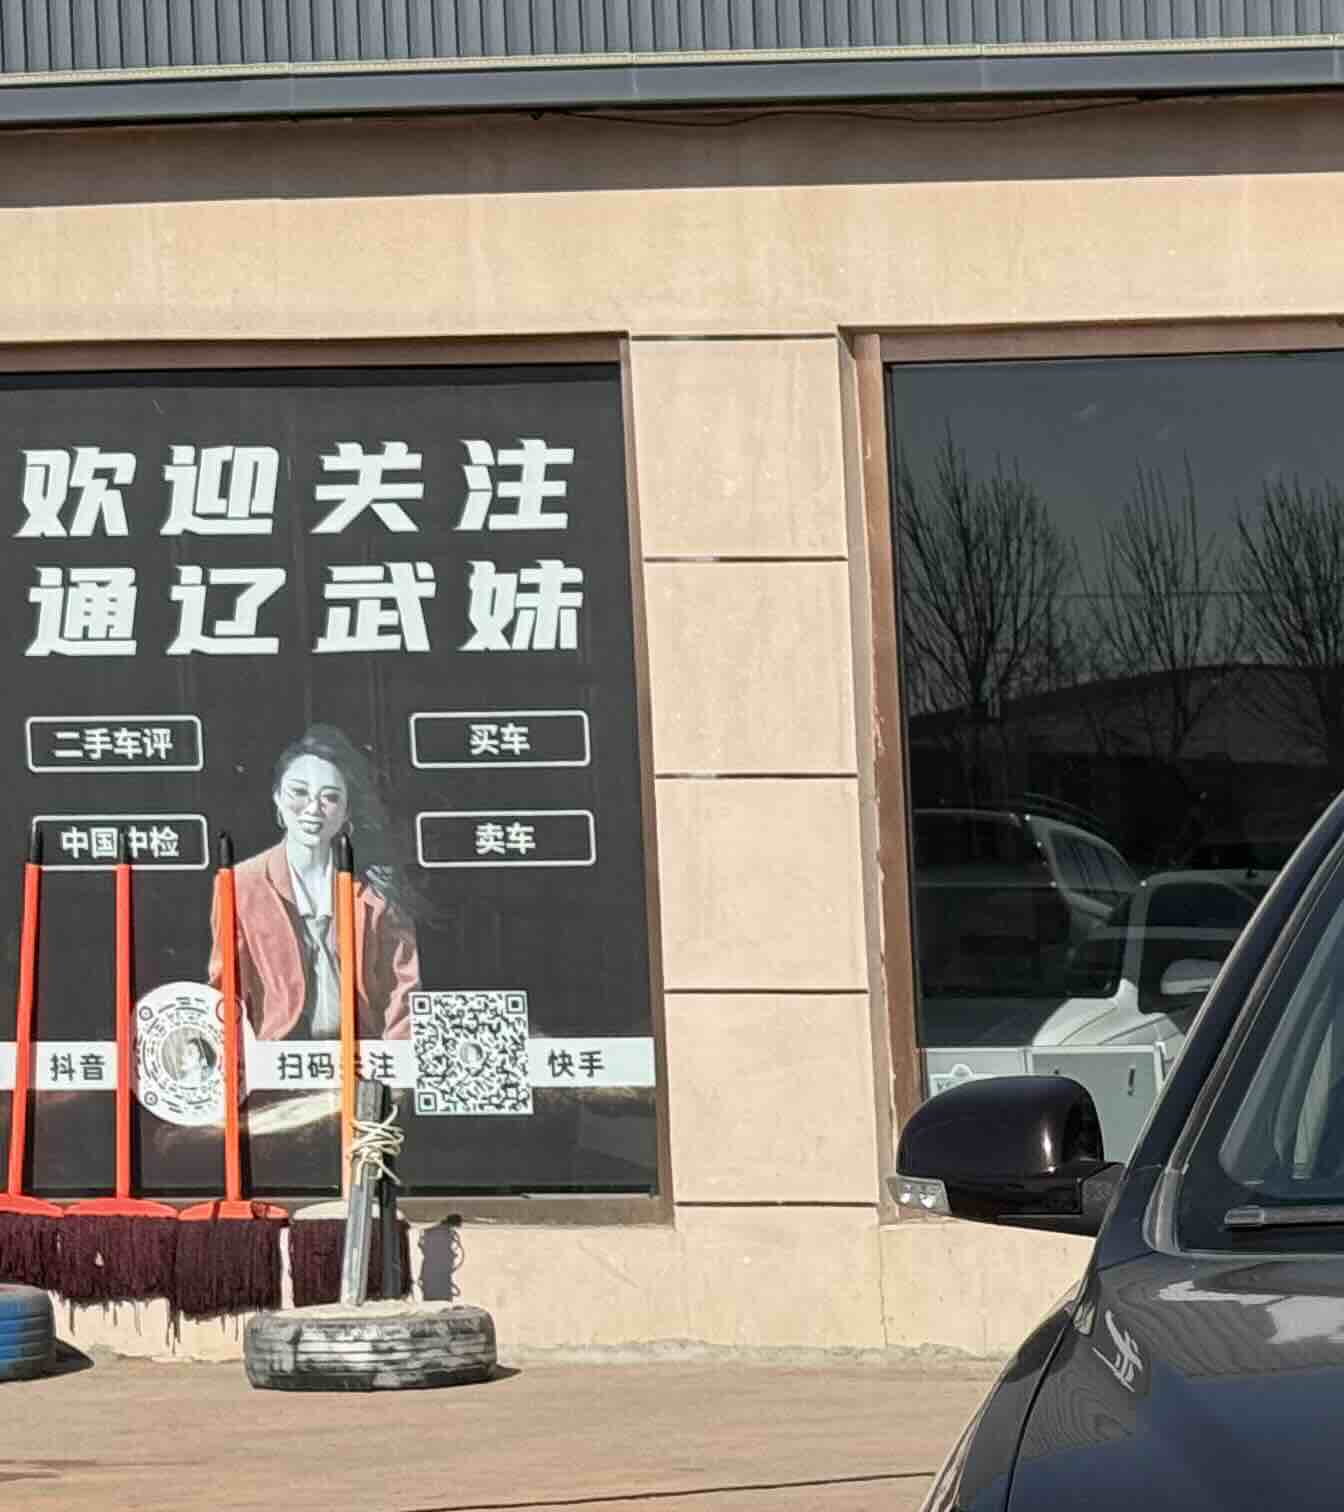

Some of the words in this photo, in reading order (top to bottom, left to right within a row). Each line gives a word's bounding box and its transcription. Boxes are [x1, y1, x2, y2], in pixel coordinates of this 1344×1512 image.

[13, 438, 575, 538] 欢迎关注
[26, 560, 583, 656] 通辽武妹
[55, 728, 172, 759] 二手车评
[471, 723, 530, 754] 买车
[476, 822, 535, 854] 卖车
[50, 1054, 105, 1081] 抖音
[278, 1050, 395, 1080] 扫码注
[548, 1051, 604, 1077] 快手
